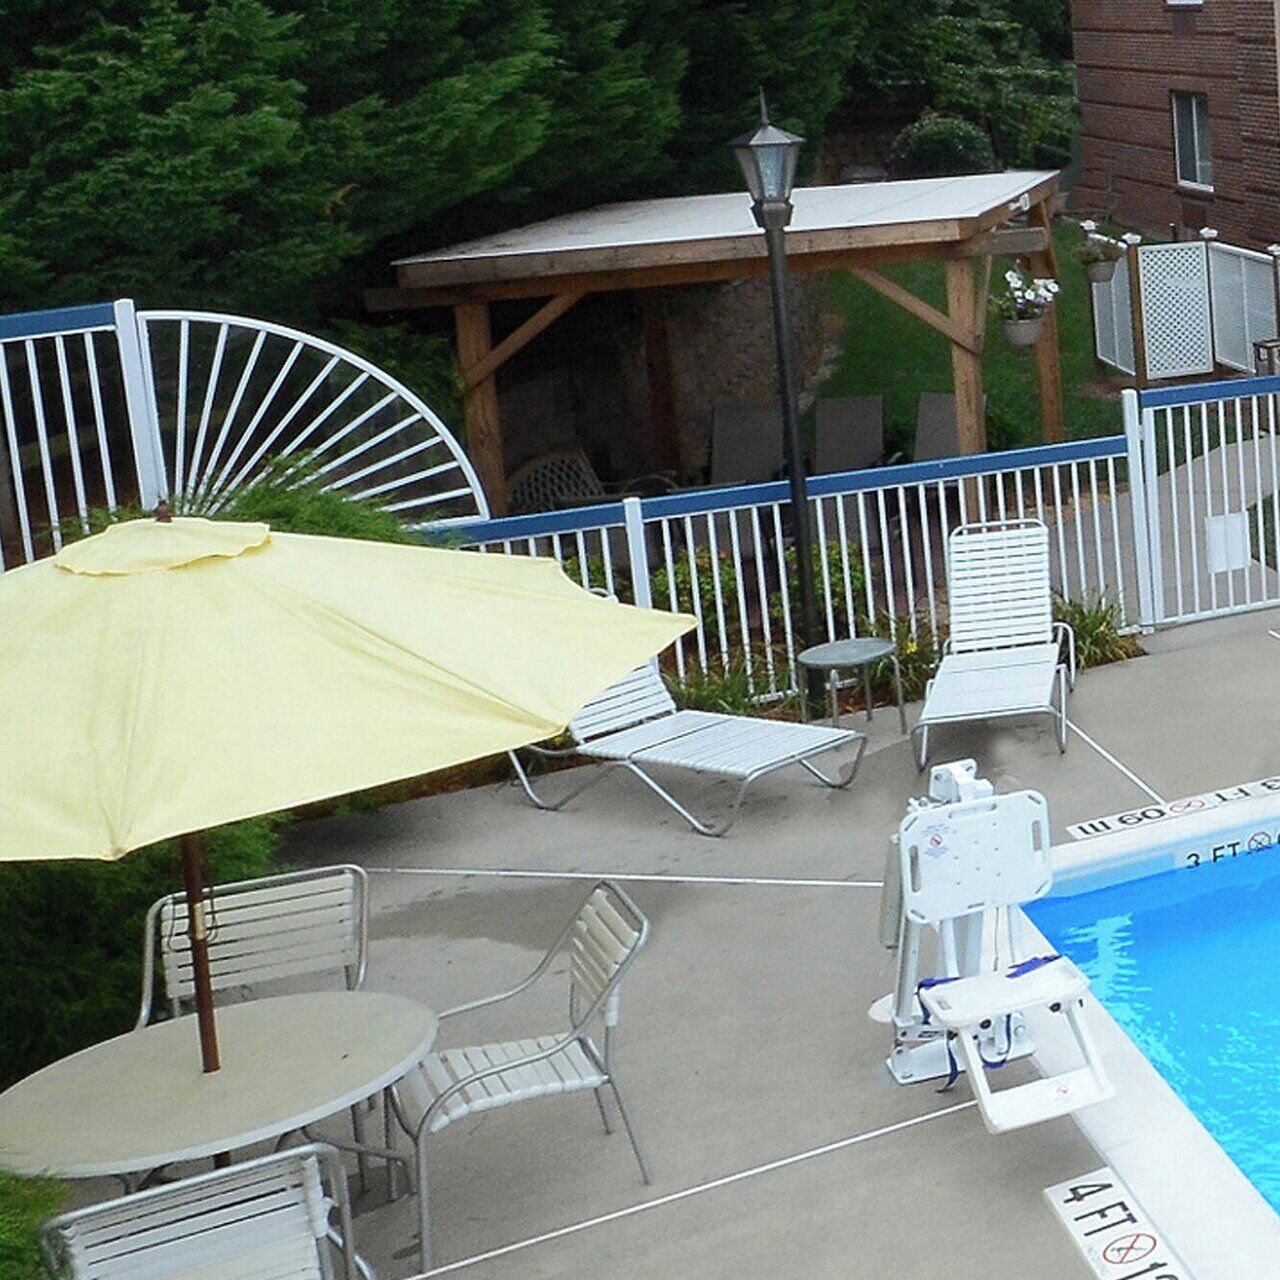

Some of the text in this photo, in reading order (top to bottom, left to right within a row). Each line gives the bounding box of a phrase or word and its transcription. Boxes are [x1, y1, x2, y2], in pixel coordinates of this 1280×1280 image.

[1212, 842, 1241, 863] FT
[1063, 1183, 1113, 1204] 4
[1073, 1201, 1138, 1237] FT
